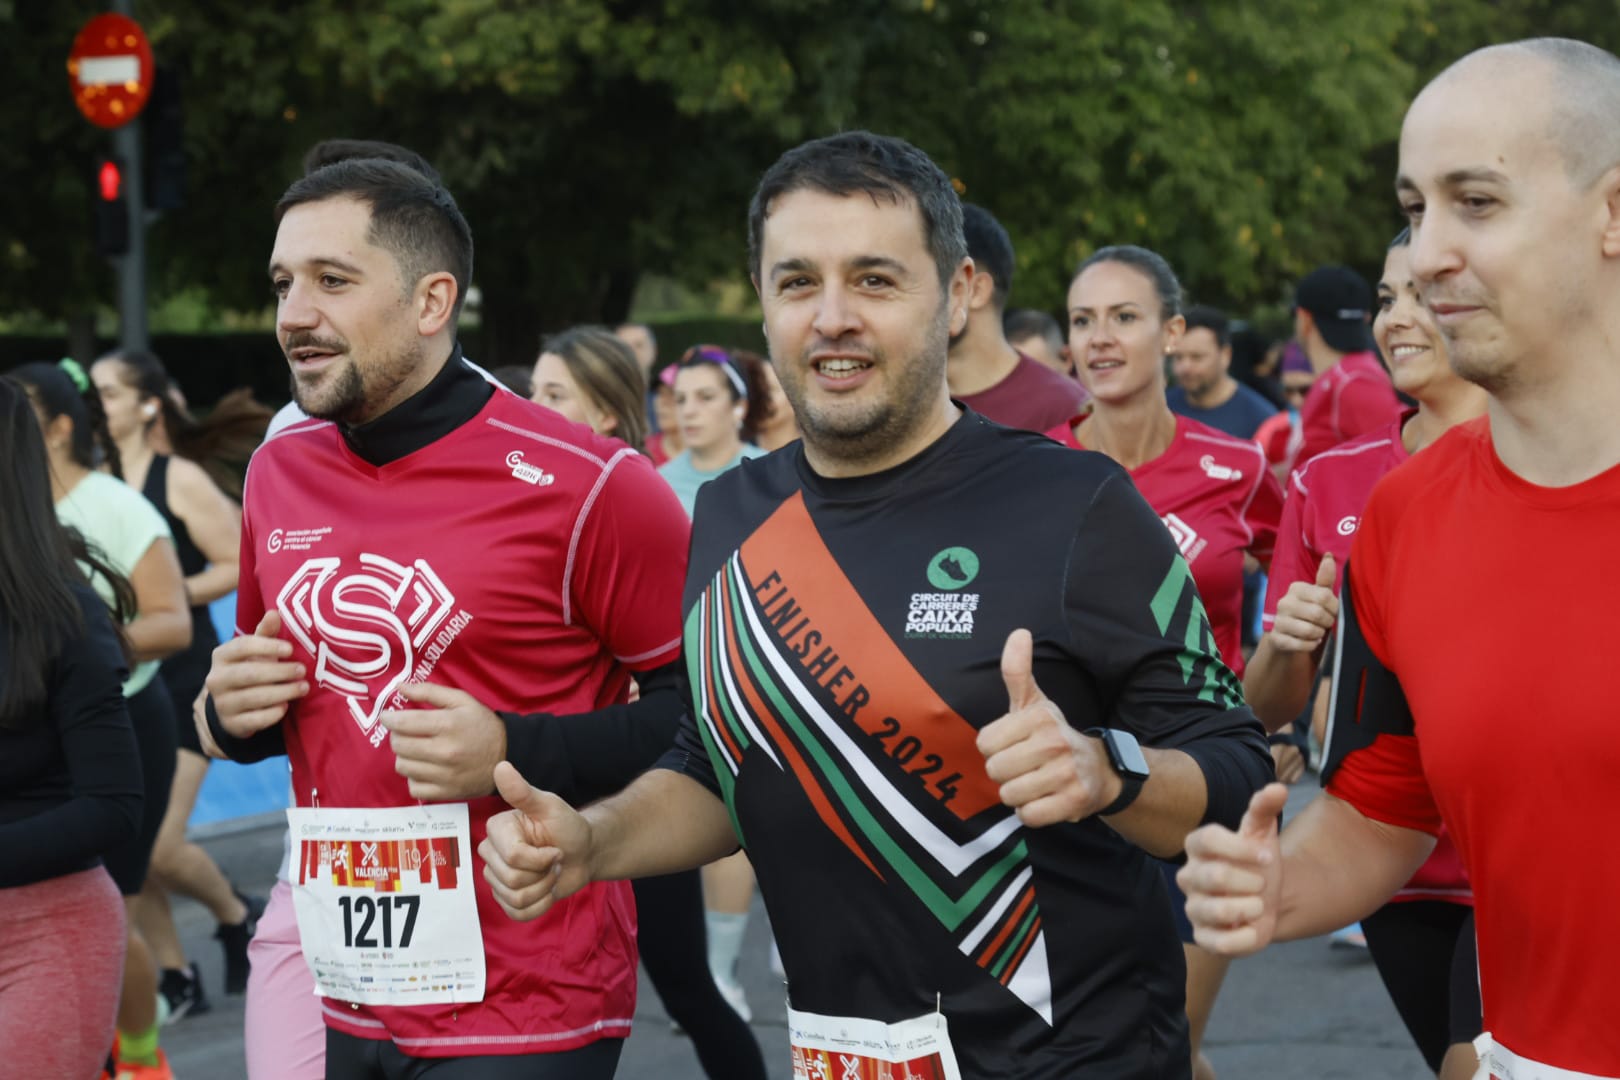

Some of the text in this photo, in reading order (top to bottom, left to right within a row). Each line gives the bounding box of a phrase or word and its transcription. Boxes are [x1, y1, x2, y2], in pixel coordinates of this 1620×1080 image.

[911, 593, 980, 603] CIRCUIT DE
[909, 601, 978, 611] CARRERES
[907, 610, 974, 623] CAIXA
[905, 622, 973, 633] POPULAR
[424, 609, 474, 664] SOLIDARIA
[754, 570, 964, 803] FINISHER 2024
[338, 895, 421, 948] 1217
